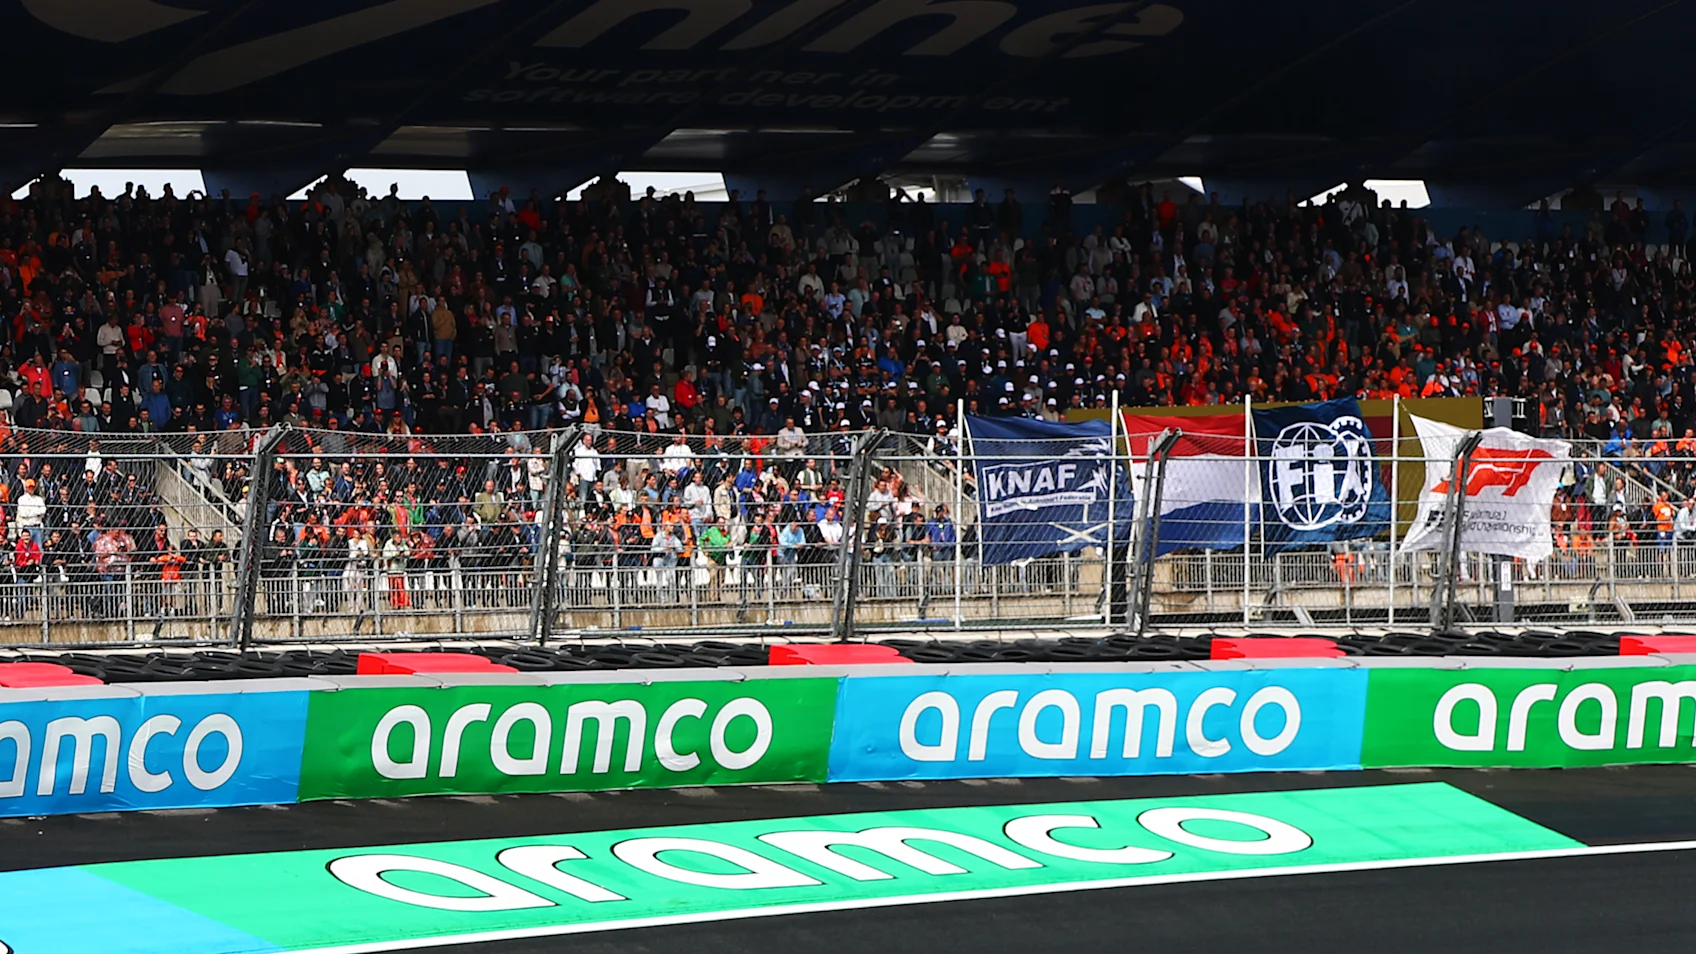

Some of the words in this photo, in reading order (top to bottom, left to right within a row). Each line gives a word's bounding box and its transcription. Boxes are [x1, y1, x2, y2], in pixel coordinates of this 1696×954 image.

[504, 61, 620, 84] Your
[851, 69, 902, 86] in
[988, 464, 1077, 500] KNAF
[371, 698, 774, 781] aramco
[899, 686, 1301, 762] aramco
[328, 806, 1313, 912] aramco
